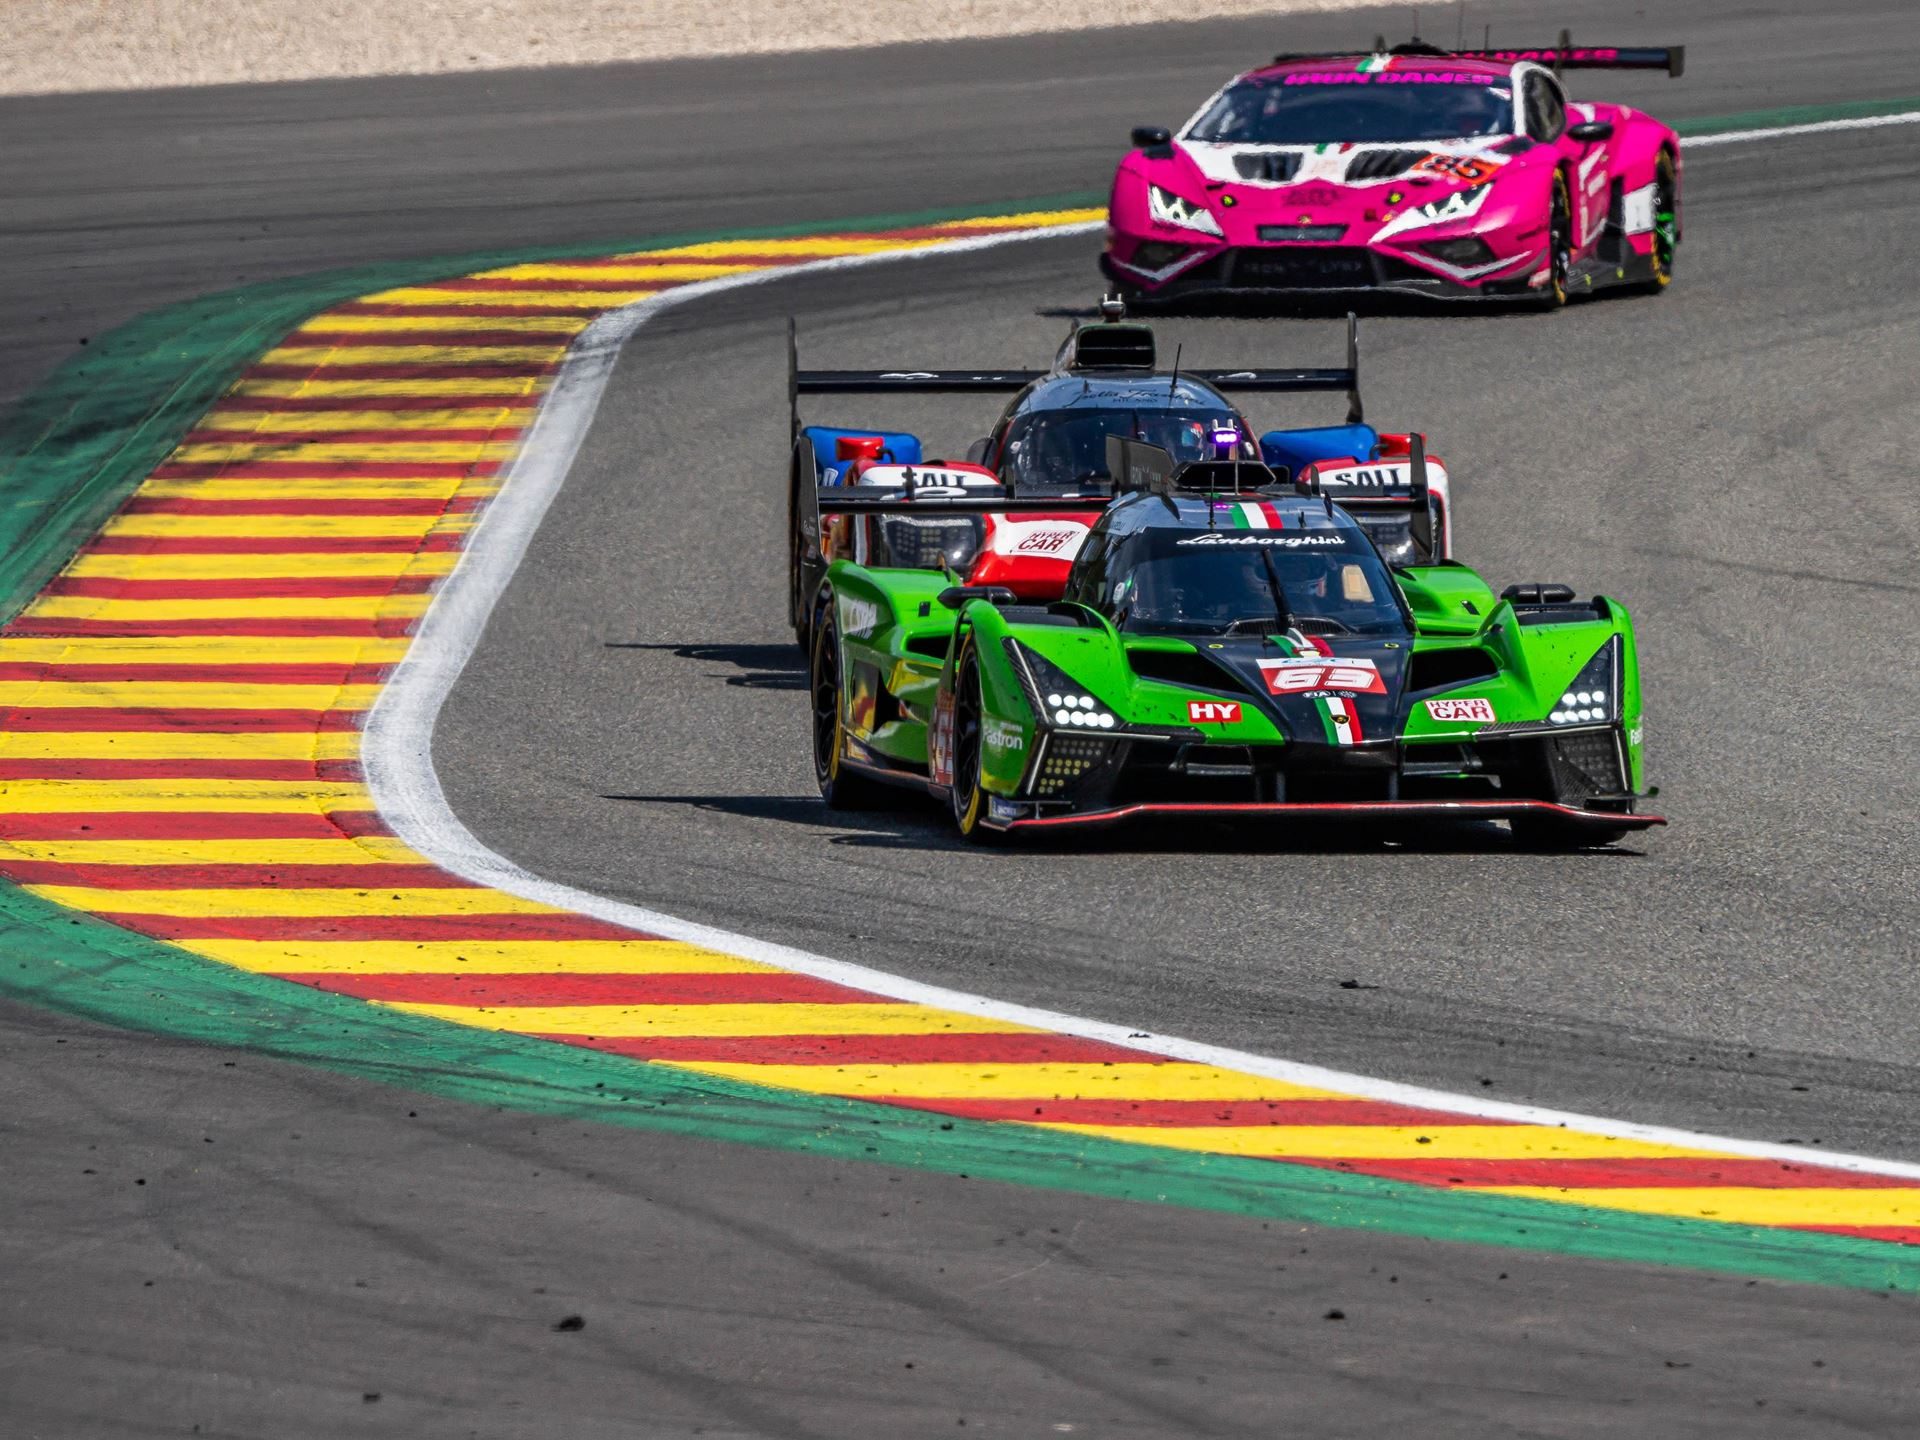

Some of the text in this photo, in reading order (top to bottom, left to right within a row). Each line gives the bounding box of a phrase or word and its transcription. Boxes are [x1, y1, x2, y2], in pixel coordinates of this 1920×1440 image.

[1335, 467, 1401, 486] SALT
[1018, 538, 1064, 551] CAR
[1176, 533, 1346, 548] Lamborghini
[1272, 667, 1376, 690] 63
[1190, 703, 1238, 719] HY
[1429, 700, 1486, 708] HYPER
[1433, 706, 1490, 719] CAR
